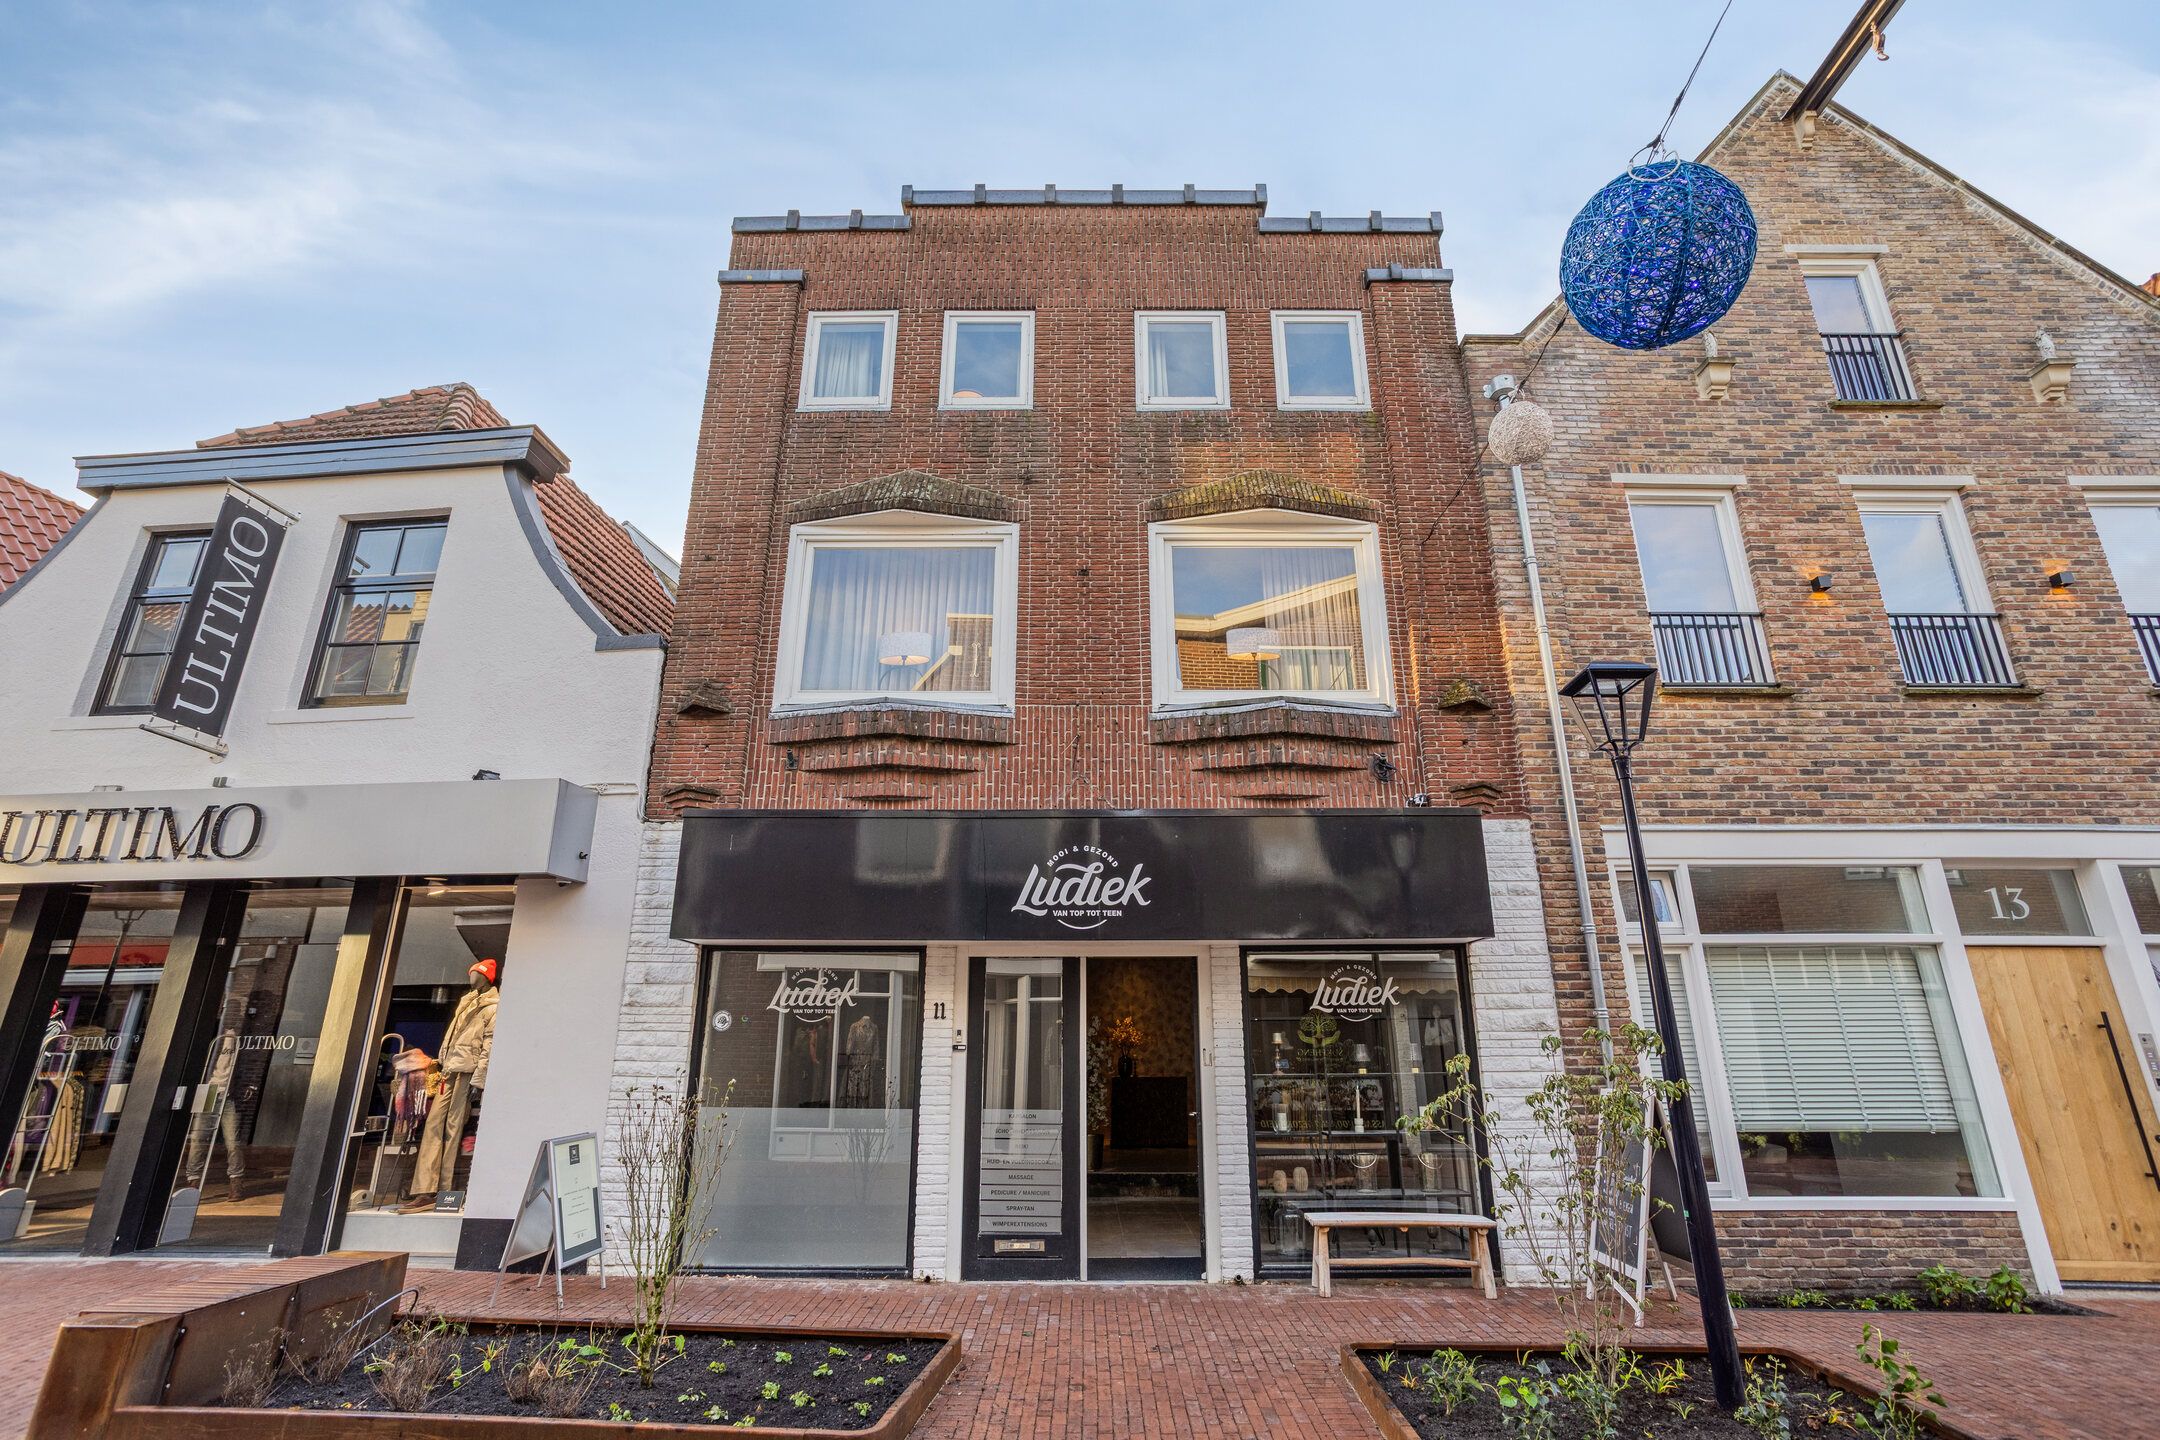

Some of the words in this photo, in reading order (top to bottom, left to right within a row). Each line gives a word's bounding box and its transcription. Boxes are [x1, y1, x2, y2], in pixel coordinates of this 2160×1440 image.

[172, 516, 269, 715] ULTIMO
[0, 803, 263, 864] ULTIMO
[1046, 848, 1069, 867] MOOI
[1083, 845, 1119, 868] GEZOND
[1011, 861, 1152, 917] Ludiek
[1983, 885, 2030, 921] 13
[1052, 909, 1068, 917] VAN
[1069, 909, 1084, 917] TOP
[1086, 909, 1101, 917] TOT
[1102, 909, 1122, 917] TEEN
[1330, 966, 1345, 980] MOOI
[1353, 964, 1377, 980] GEZOND
[766, 977, 858, 1014] Ludiek
[1309, 976, 1400, 1013] Ludiek
[933, 1002, 947, 1020] 11
[63, 1035, 122, 1051] ULTIMO
[237, 1035, 295, 1050] ULTIMO
